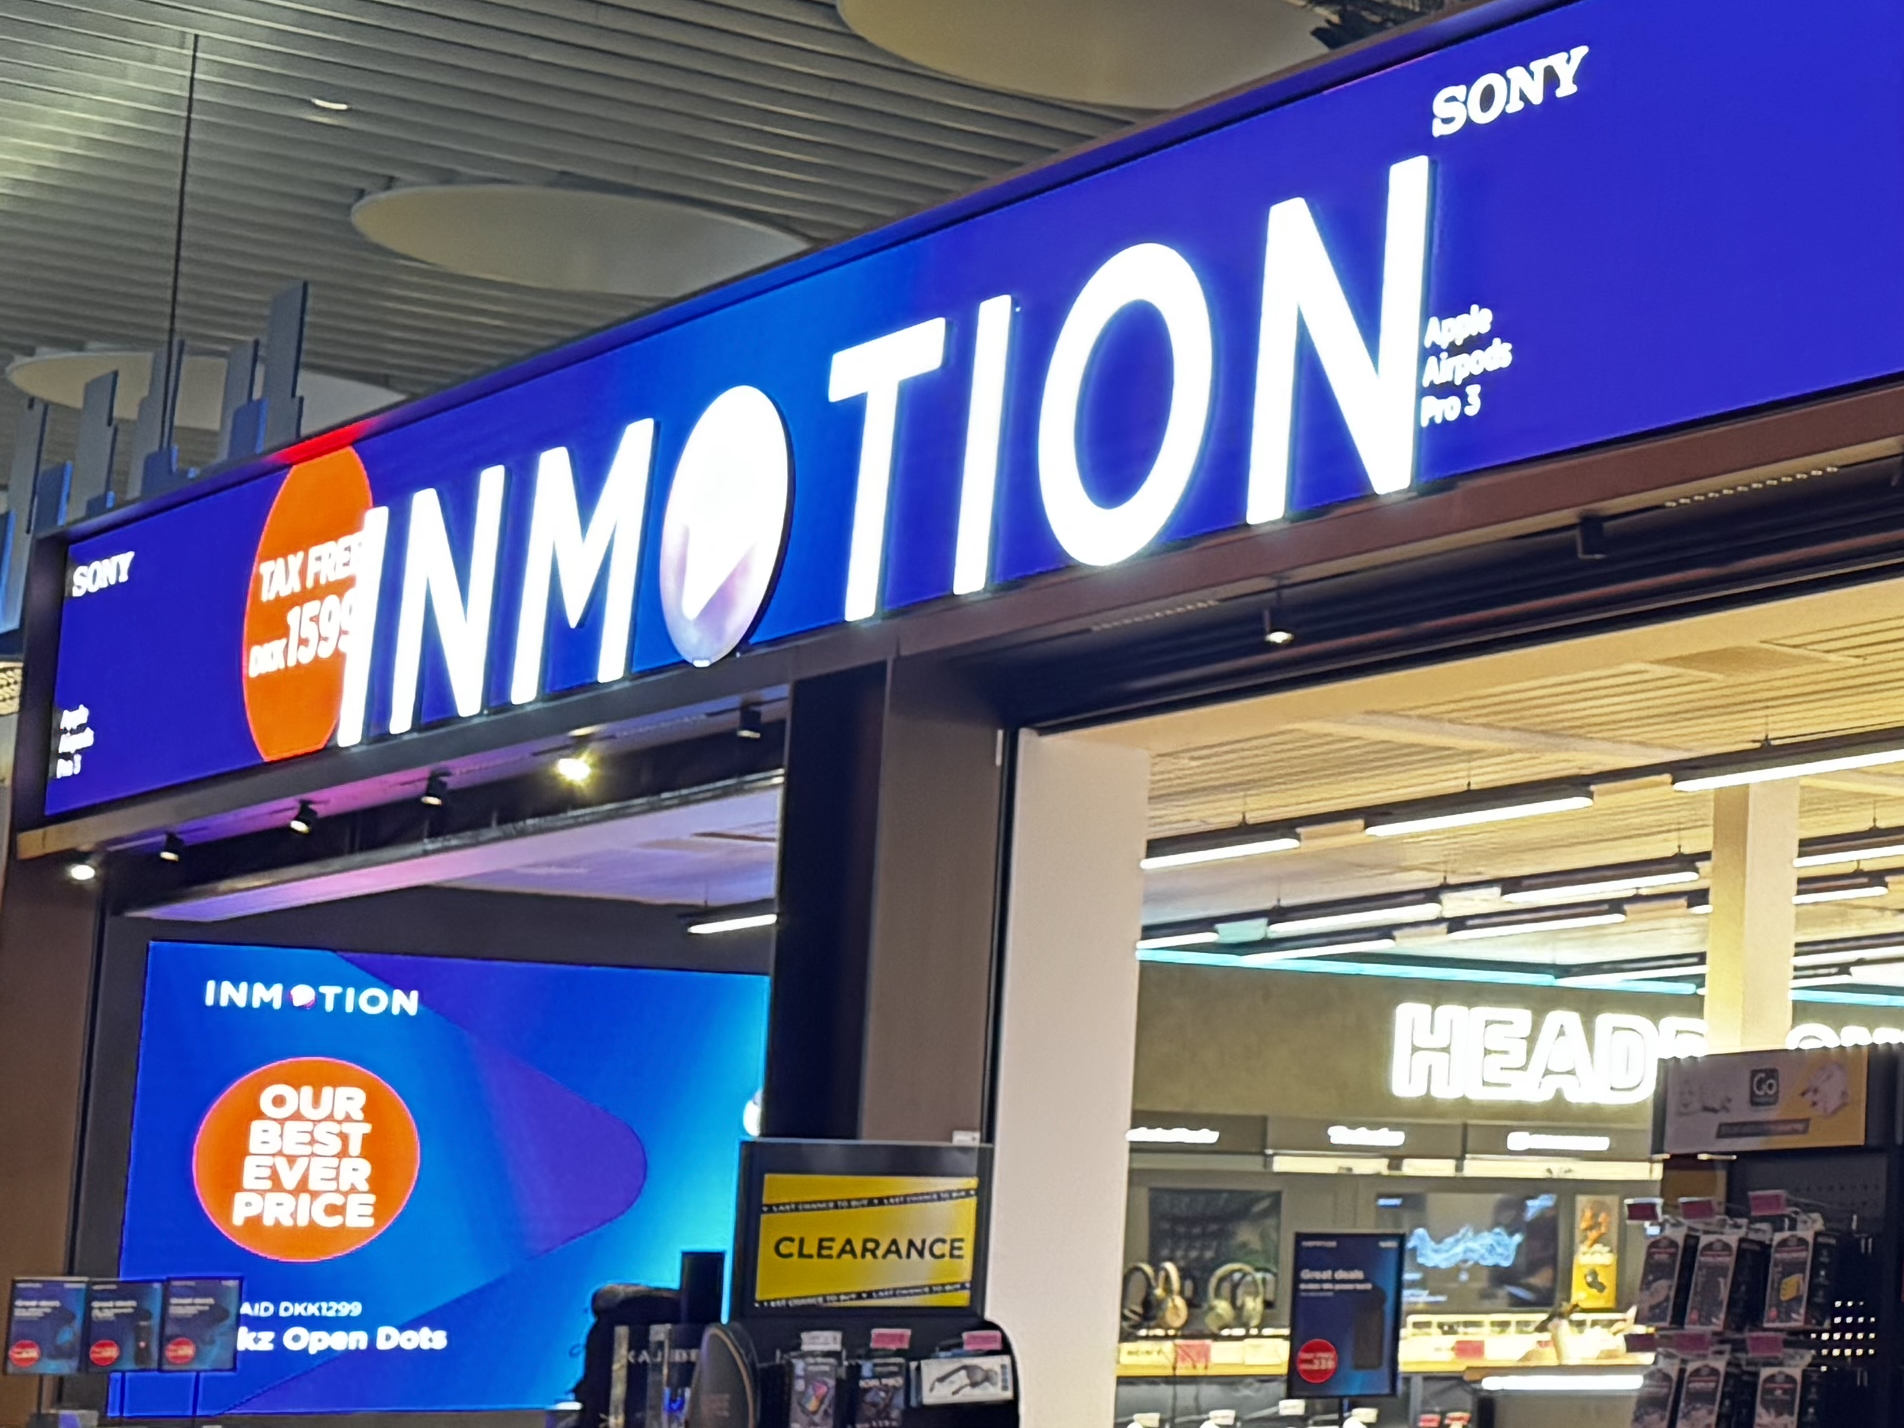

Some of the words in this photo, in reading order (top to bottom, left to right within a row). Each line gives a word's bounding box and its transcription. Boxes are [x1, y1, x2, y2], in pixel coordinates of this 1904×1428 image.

[1432, 45, 1589, 138] SONY
[1424, 304, 1493, 349] Apple
[1422, 337, 1513, 388] Airpods
[1420, 395, 1461, 427] Pro
[1464, 384, 1481, 416] 3
[337, 155, 1430, 747] INMOTION
[72, 551, 135, 597] SONY
[259, 550, 304, 602] TAX
[205, 979, 419, 1016] INMOTION
[259, 1084, 366, 1121] OUR
[249, 1119, 372, 1156] BEST
[242, 1155, 372, 1192] EVER
[232, 1192, 376, 1228] PRICE
[774, 1236, 965, 1260] CLEARANCE
[240, 1302, 272, 1317] AID
[237, 1326, 275, 1351] kz
[283, 1327, 368, 1354] Open
[376, 1325, 448, 1351] Dots
